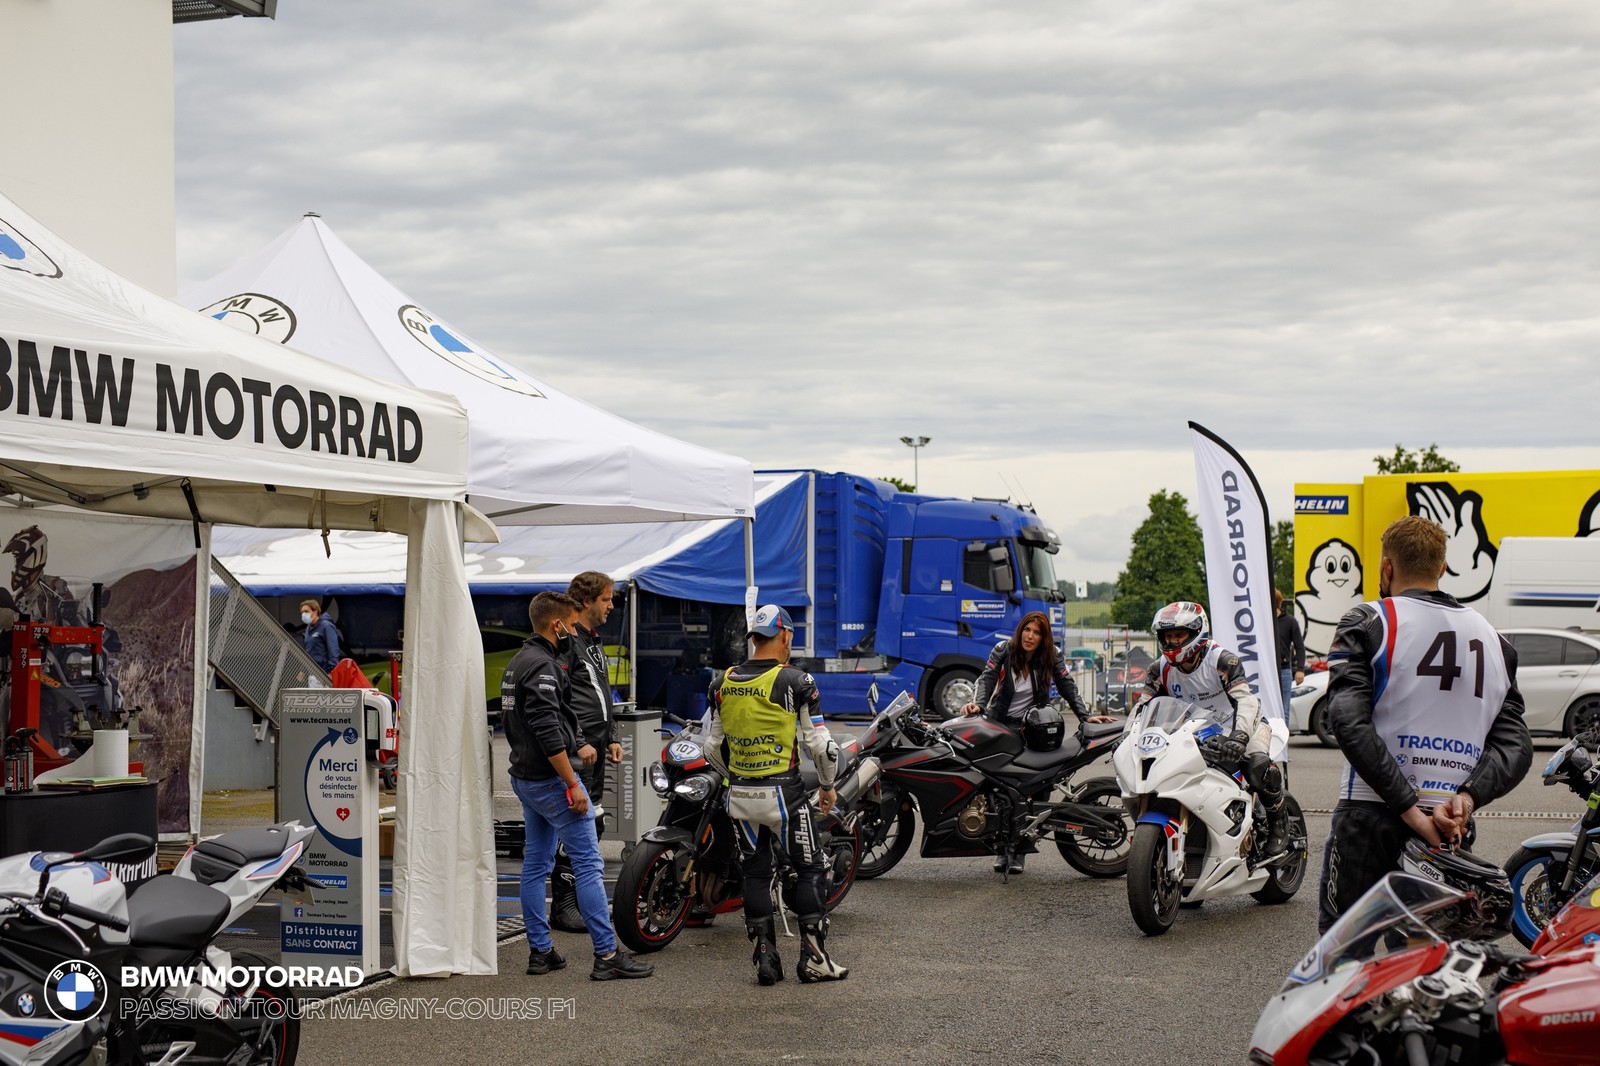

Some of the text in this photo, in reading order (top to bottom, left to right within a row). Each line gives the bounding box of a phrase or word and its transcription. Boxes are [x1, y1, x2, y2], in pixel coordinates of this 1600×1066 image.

[156, 363, 423, 464] MOTORRAD
[1416, 630, 1485, 699] 41
[282, 693, 360, 708] TECMAS
[290, 717, 352, 725] www.tecmas.net
[1142, 735, 1161, 746] 174
[676, 743, 696, 755] 107
[1397, 735, 1481, 761] TRACKDAYS
[319, 759, 358, 772] Merci
[735, 759, 780, 769] MICHELIN
[1412, 756, 1438, 767] BMW
[319, 783, 358, 791] désinfecter
[285, 925, 358, 937] Distributeur
[285, 938, 358, 950] SANS CONTACT
[1540, 1011, 1596, 1027] DUCATI
